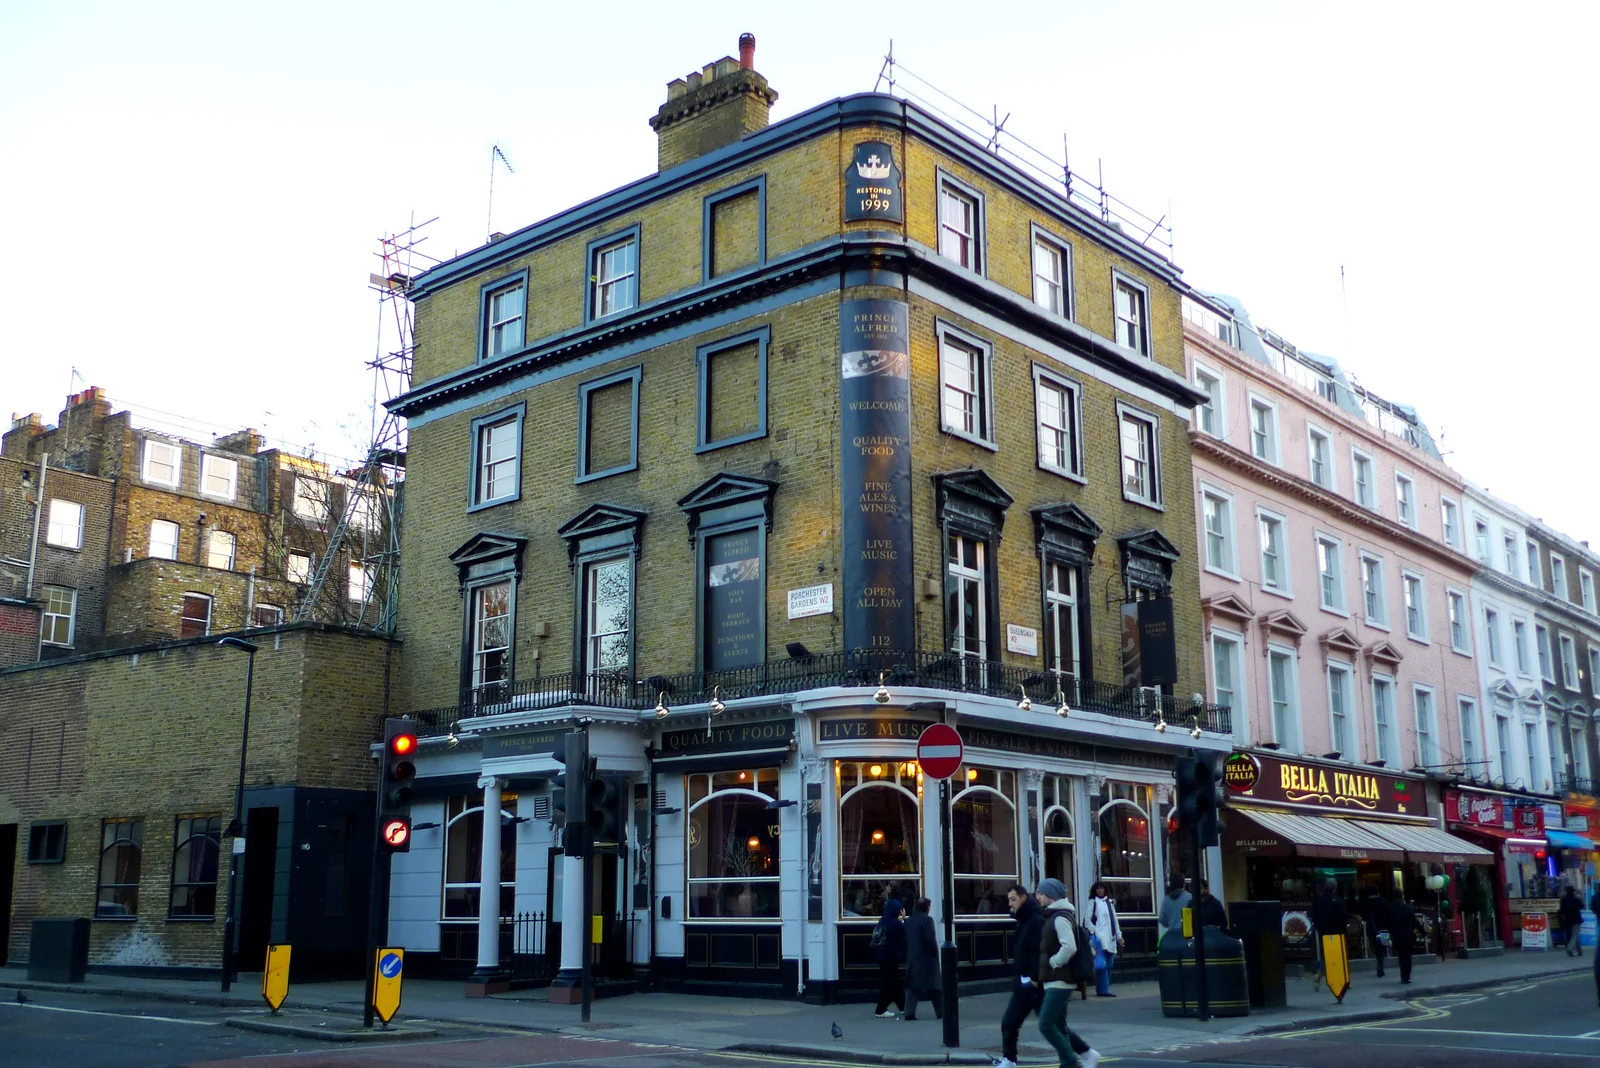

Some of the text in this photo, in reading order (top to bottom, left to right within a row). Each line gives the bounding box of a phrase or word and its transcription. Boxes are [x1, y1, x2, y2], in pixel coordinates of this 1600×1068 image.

[856, 187, 892, 195] RESTORED
[860, 199, 890, 212] 1999
[854, 314, 898, 322] PRINCE
[854, 324, 898, 333] ALFRED
[849, 400, 904, 412] WELCOME
[853, 436, 901, 448] QUALITY
[861, 447, 894, 456] FOOD
[865, 482, 892, 491] FINE
[860, 493, 897, 502] ALES &
[860, 504, 897, 512] WINES
[724, 539, 748, 548] PRINCE
[866, 540, 892, 549] LIVE
[724, 547, 749, 556] ALFRED
[861, 551, 898, 560] MUSIC
[791, 587, 827, 600] PORCHESTER
[864, 587, 896, 596] OPEN
[791, 596, 828, 610] GARDENS W2
[856, 599, 903, 608] ALL DAY
[1010, 627, 1034, 638] QUEENSWAY
[872, 636, 890, 646] 112
[824, 722, 925, 737] LIVE MUSI
[670, 724, 786, 750] QUALITY FOOD
[500, 739, 526, 748] PRINCE
[528, 736, 555, 744] ALFRED
[968, 732, 1080, 758] FINE ALES & WINES
[1226, 764, 1253, 772] BELLA
[1226, 772, 1255, 780] ITALIA
[1280, 764, 1380, 800] BELLA ITALIA
